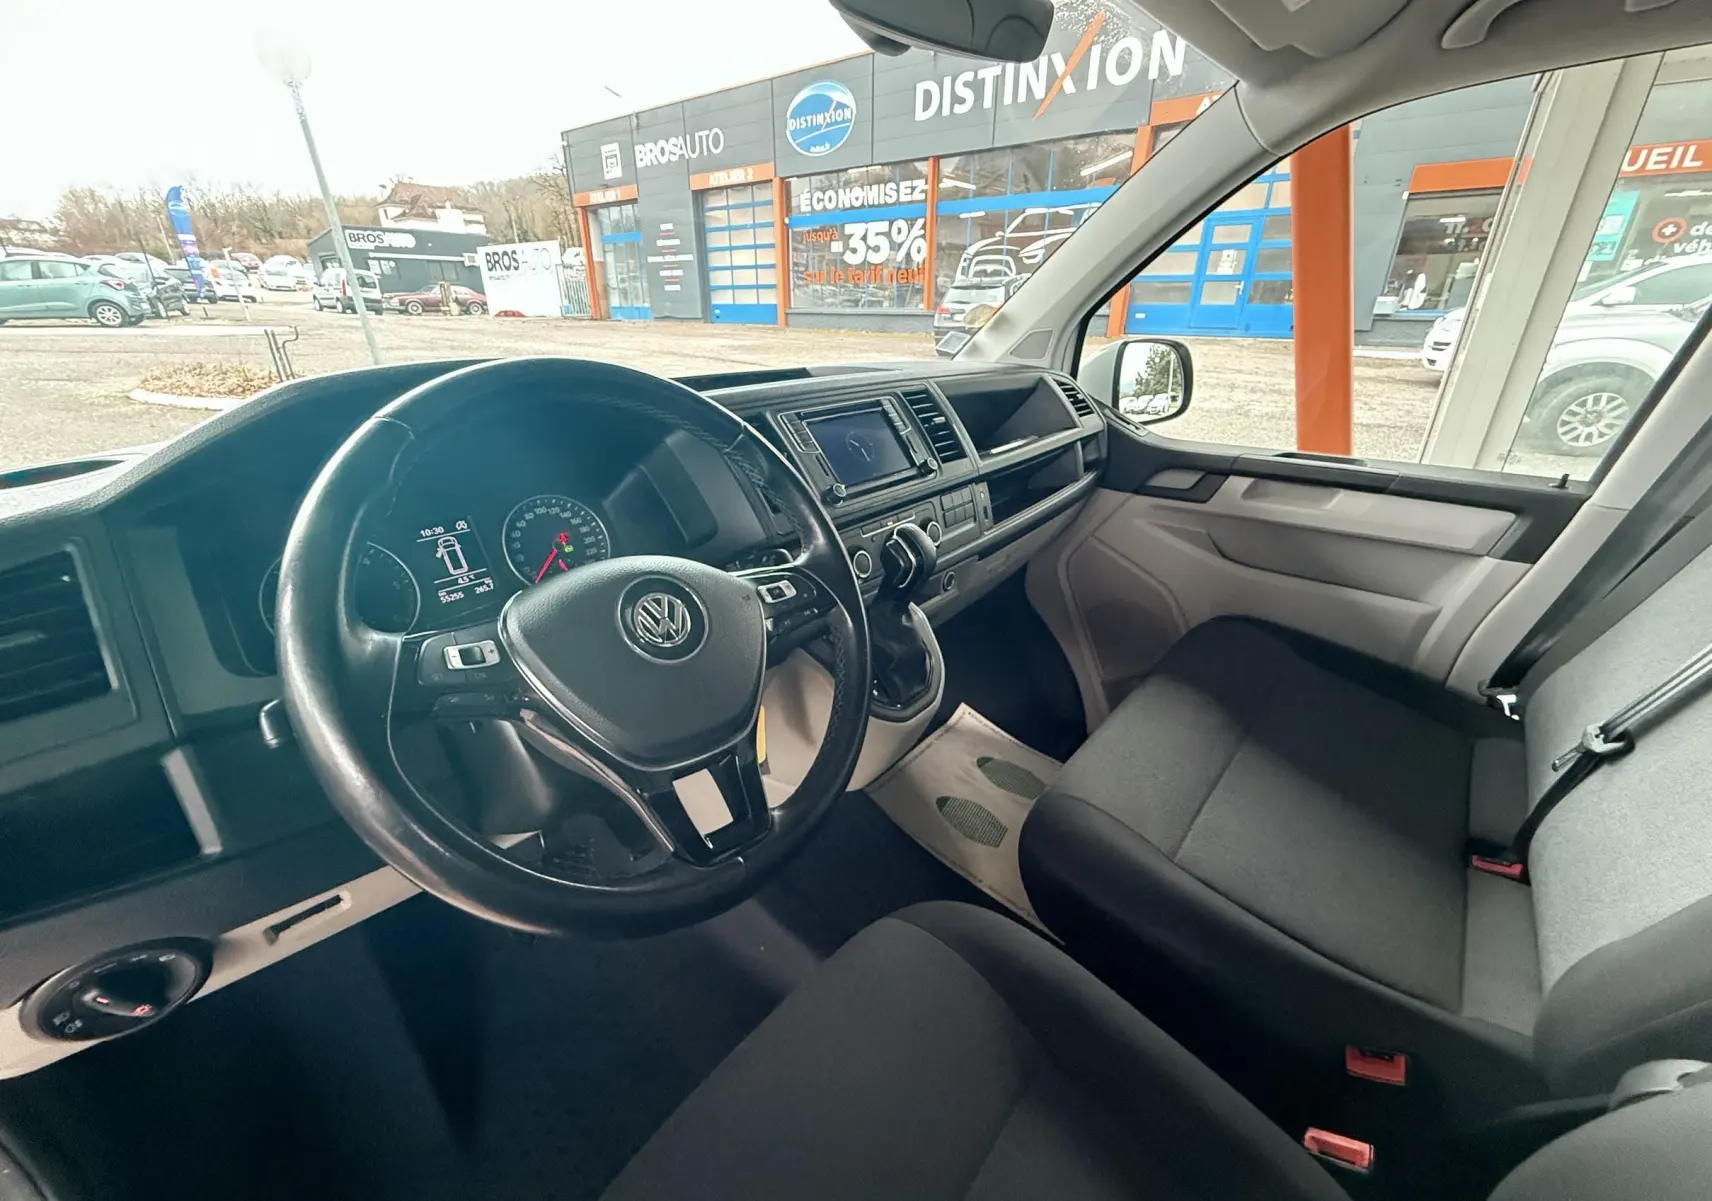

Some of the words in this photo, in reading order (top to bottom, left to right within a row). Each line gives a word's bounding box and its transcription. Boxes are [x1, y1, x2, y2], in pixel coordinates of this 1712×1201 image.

[788, 107, 852, 131] DISTINXION
[799, 178, 926, 213] ÉCONOMISEZ
[420, 526, 445, 538] 10:30
